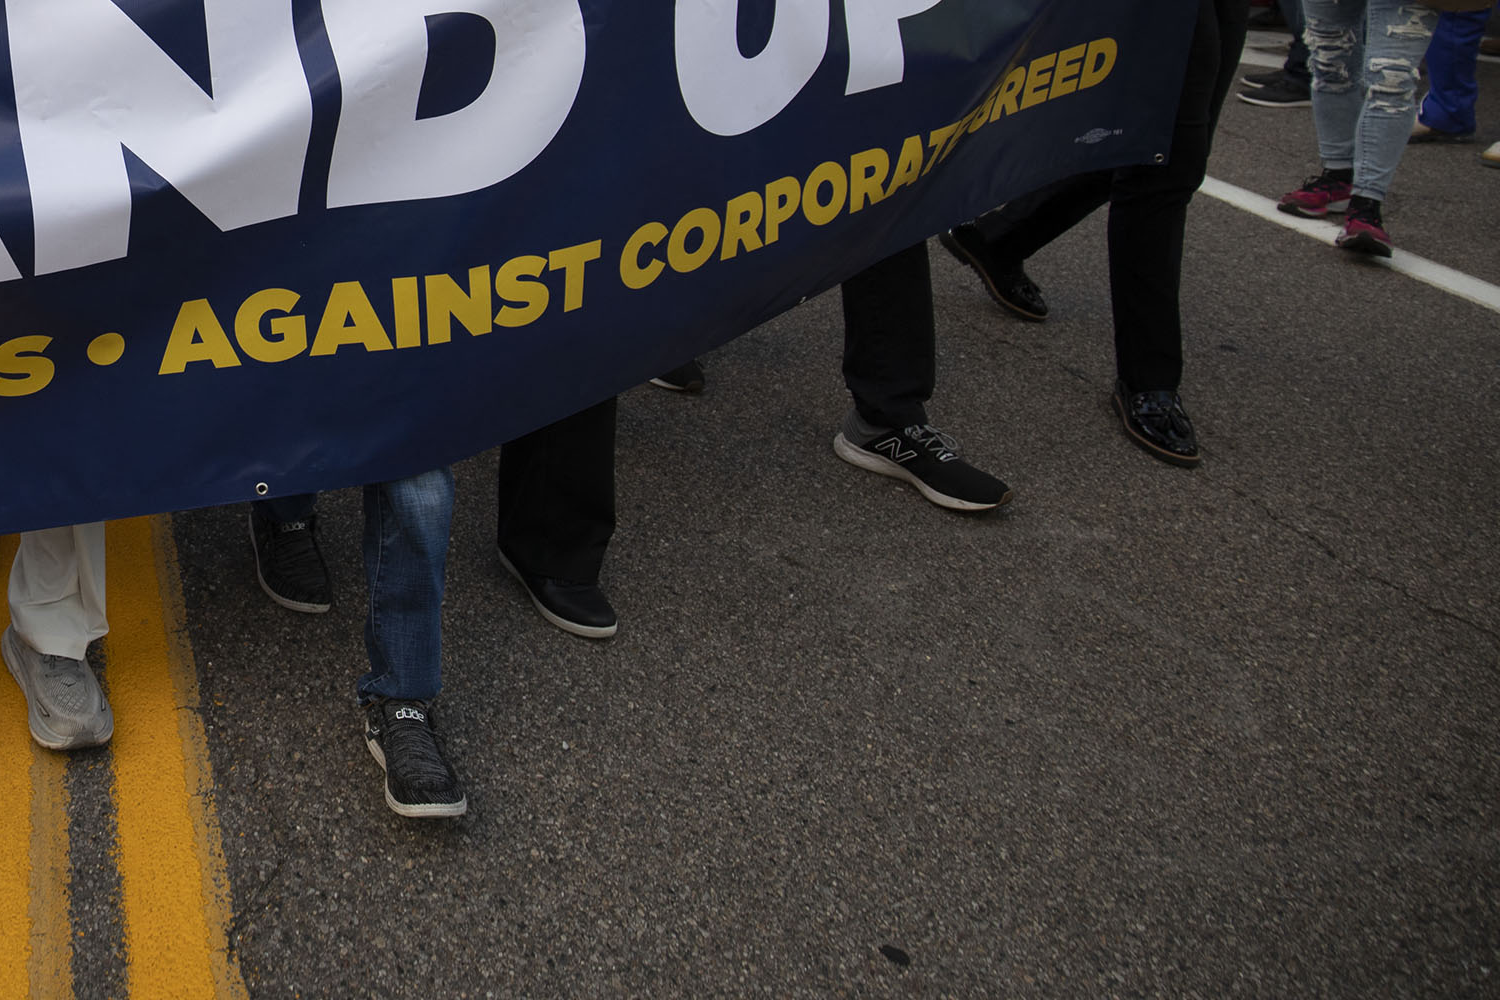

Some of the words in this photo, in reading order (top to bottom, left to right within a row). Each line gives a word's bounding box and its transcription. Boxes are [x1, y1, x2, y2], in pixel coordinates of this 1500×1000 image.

[158, 239, 601, 376] AGAINST
[967, 37, 1118, 134] GREED
[396, 708, 424, 722] dude
